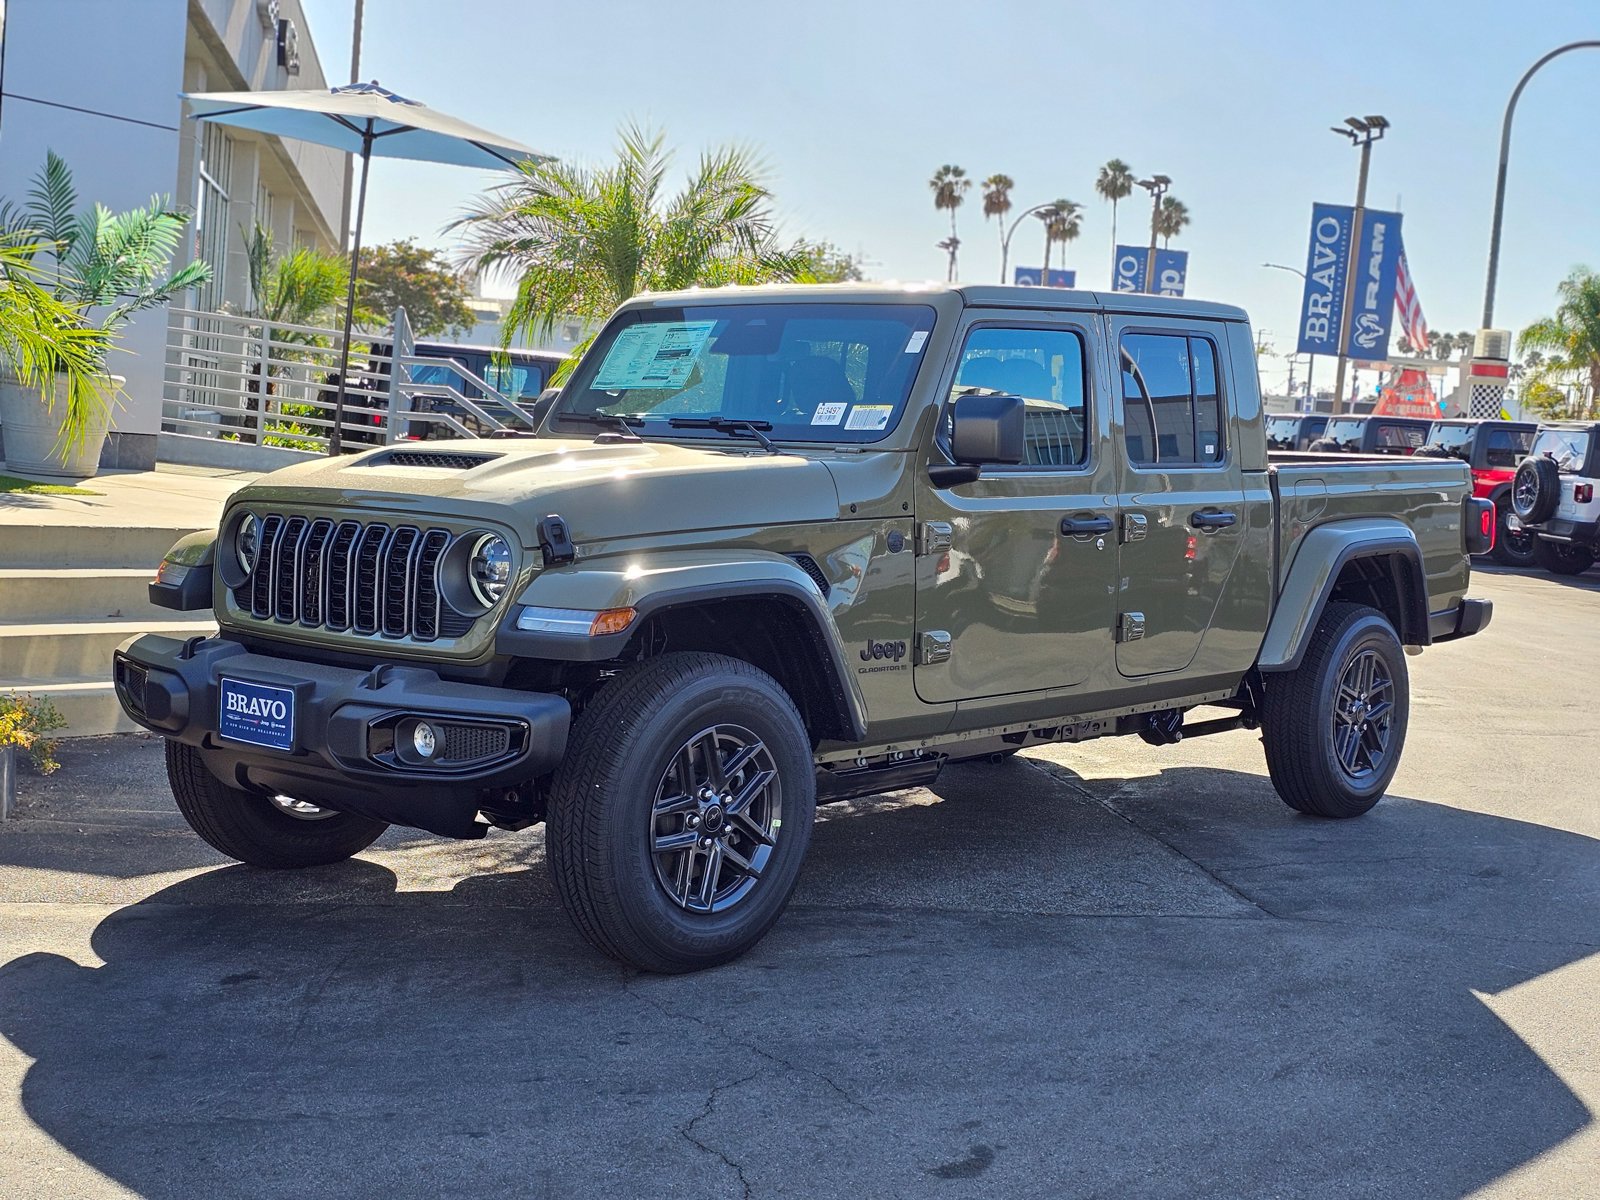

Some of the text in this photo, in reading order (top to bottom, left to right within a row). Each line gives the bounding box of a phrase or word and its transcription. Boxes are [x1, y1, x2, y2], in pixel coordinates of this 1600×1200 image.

[1305, 216, 1340, 342] BRAVO
[1365, 222, 1386, 310] RAM
[860, 638, 906, 662] Jeep
[858, 666, 900, 674] GLADIATOR
[226, 691, 287, 720] BRAVO
